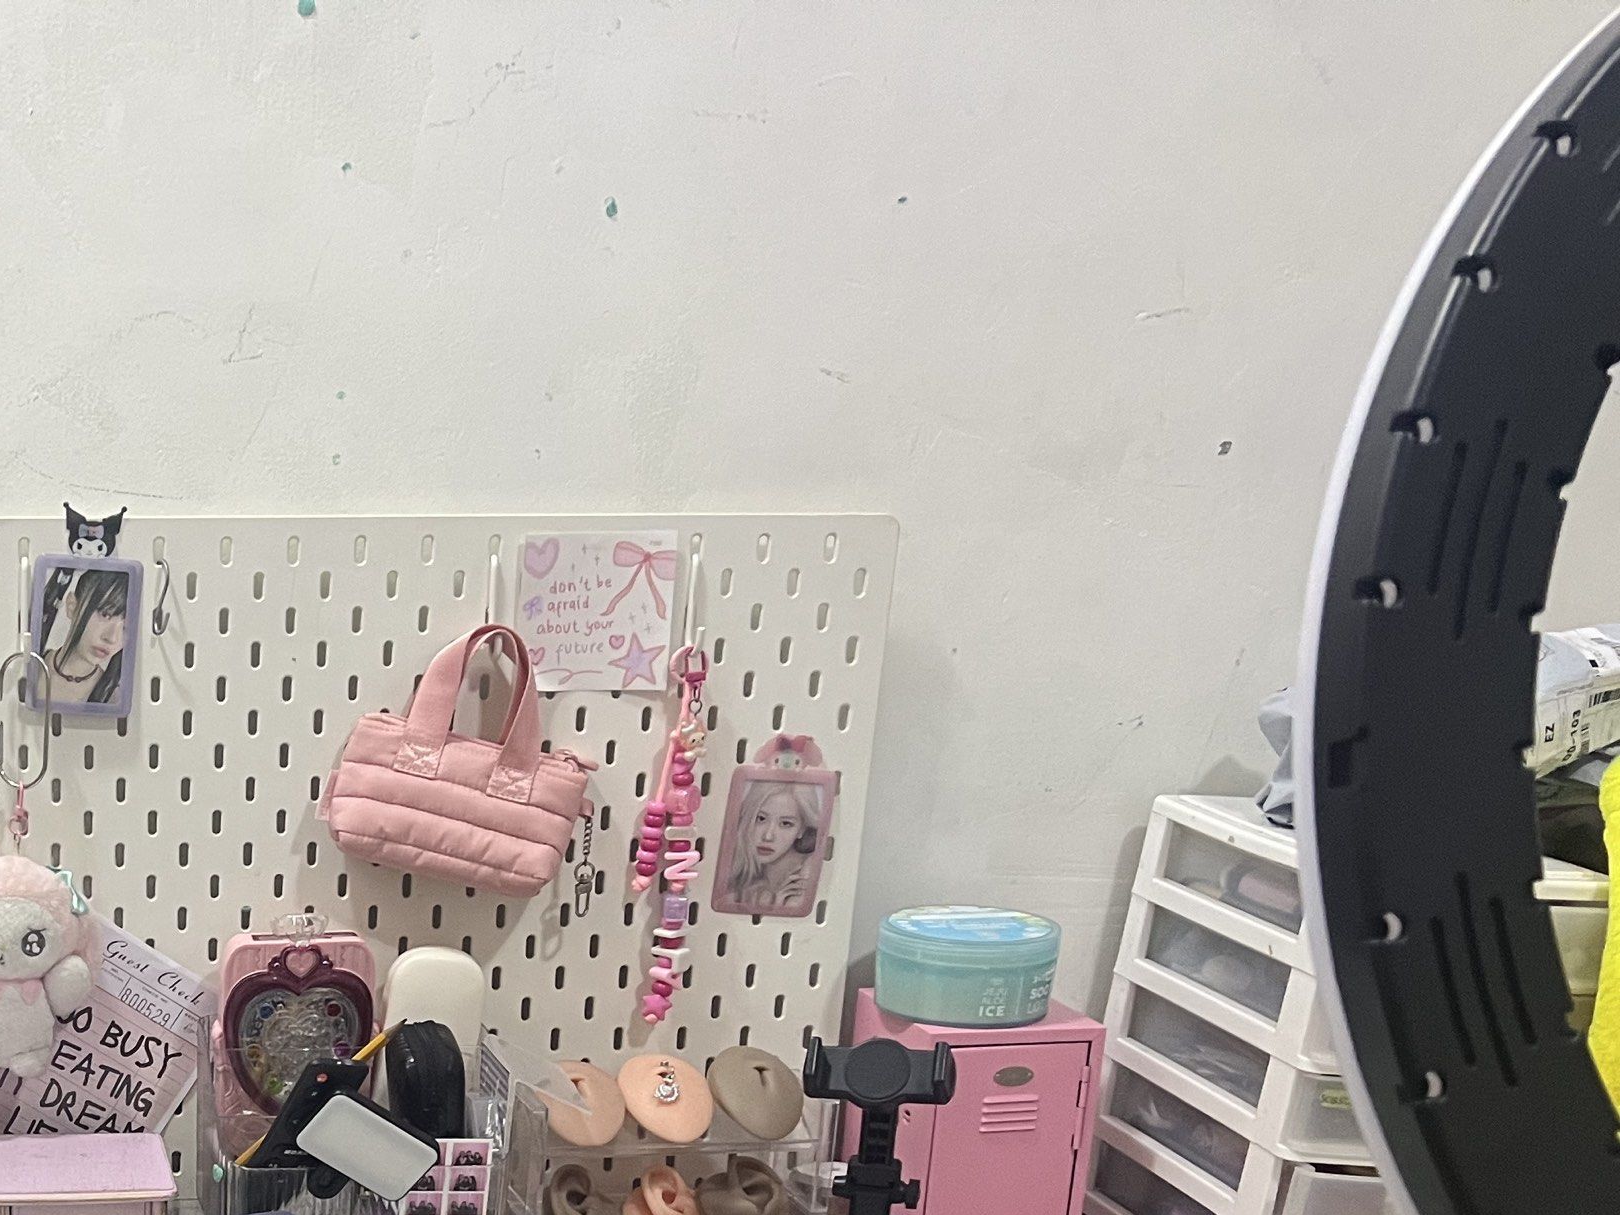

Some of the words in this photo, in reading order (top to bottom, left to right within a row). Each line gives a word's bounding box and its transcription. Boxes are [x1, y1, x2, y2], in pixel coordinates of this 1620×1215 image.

[549, 577, 591, 594] don't
[596, 574, 613, 588] be
[547, 596, 590, 617] afraid
[536, 619, 580, 635] about
[584, 619, 614, 637] your
[555, 641, 605, 666] future
[1544, 722, 1555, 743] EZ
[102, 940, 150, 973] Guest
[157, 971, 205, 1006] Check
[120, 988, 171, 1027] 800529
[978, 1005, 1006, 1017] ICE
[99, 1020, 182, 1079] BUSY
